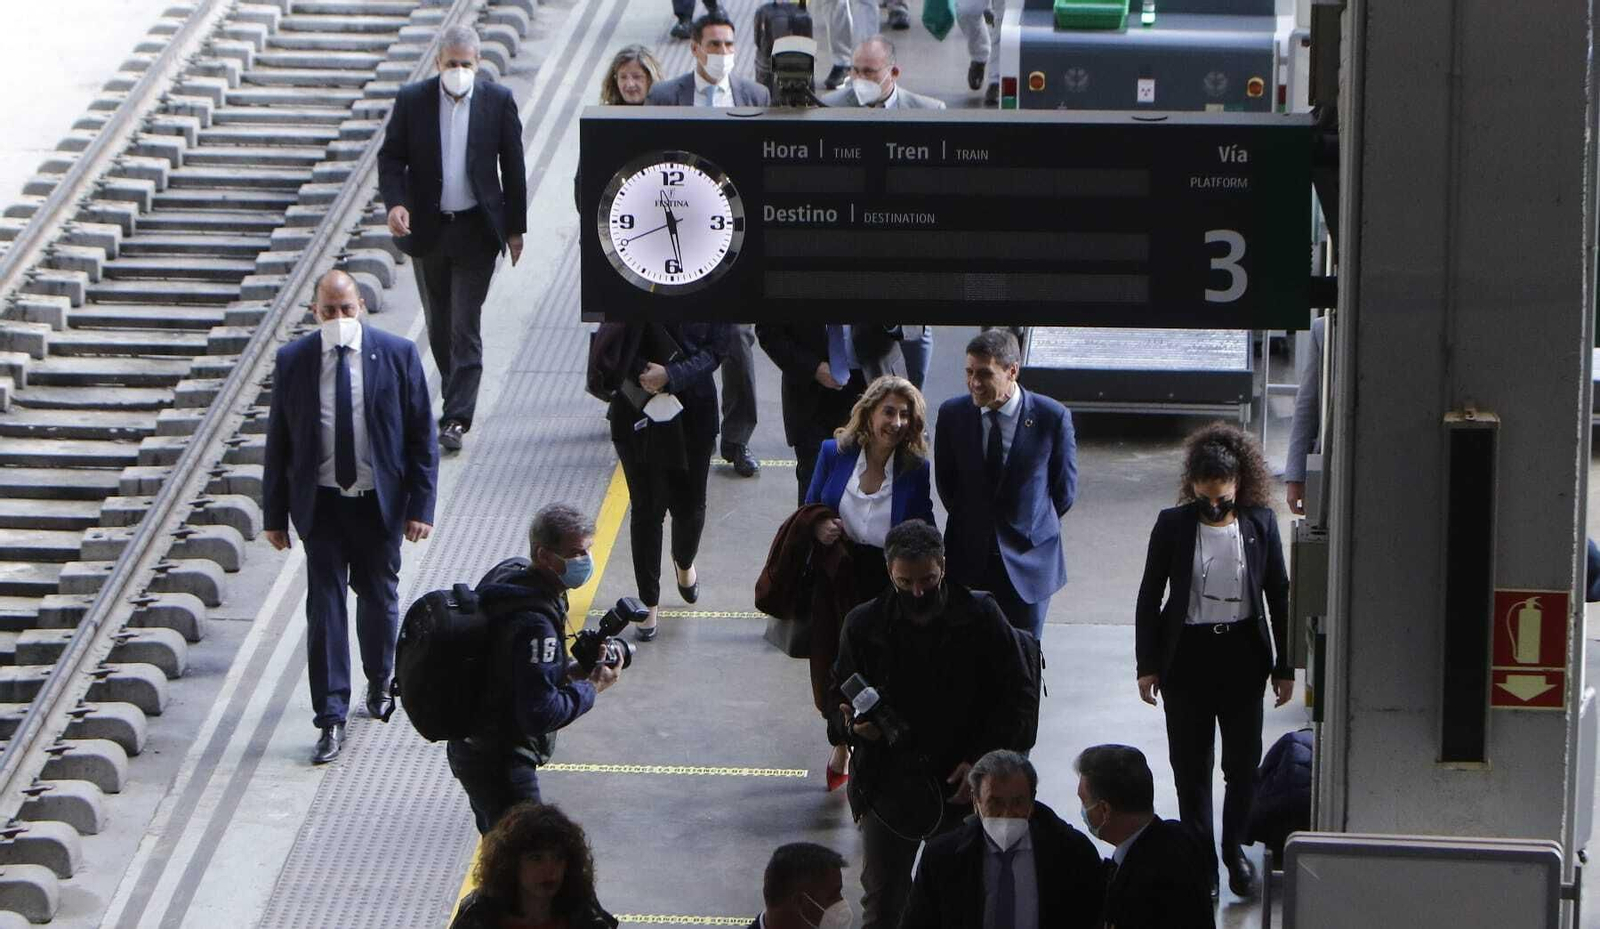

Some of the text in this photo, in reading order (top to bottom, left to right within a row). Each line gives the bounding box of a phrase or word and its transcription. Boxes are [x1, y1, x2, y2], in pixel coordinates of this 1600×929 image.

[763, 141, 861, 159] Hora TIME
[886, 142, 989, 161] Tren TRAIN
[1218, 144, 1249, 163] Vía
[661, 171, 685, 186] 12
[1190, 177, 1248, 189] PLATFORM
[619, 214, 635, 230] 9
[710, 215, 725, 231] 3
[763, 204, 936, 225] Destino DESTINATION
[665, 259, 680, 274] 6
[1204, 229, 1248, 304] 3
[530, 637, 557, 664] 16
